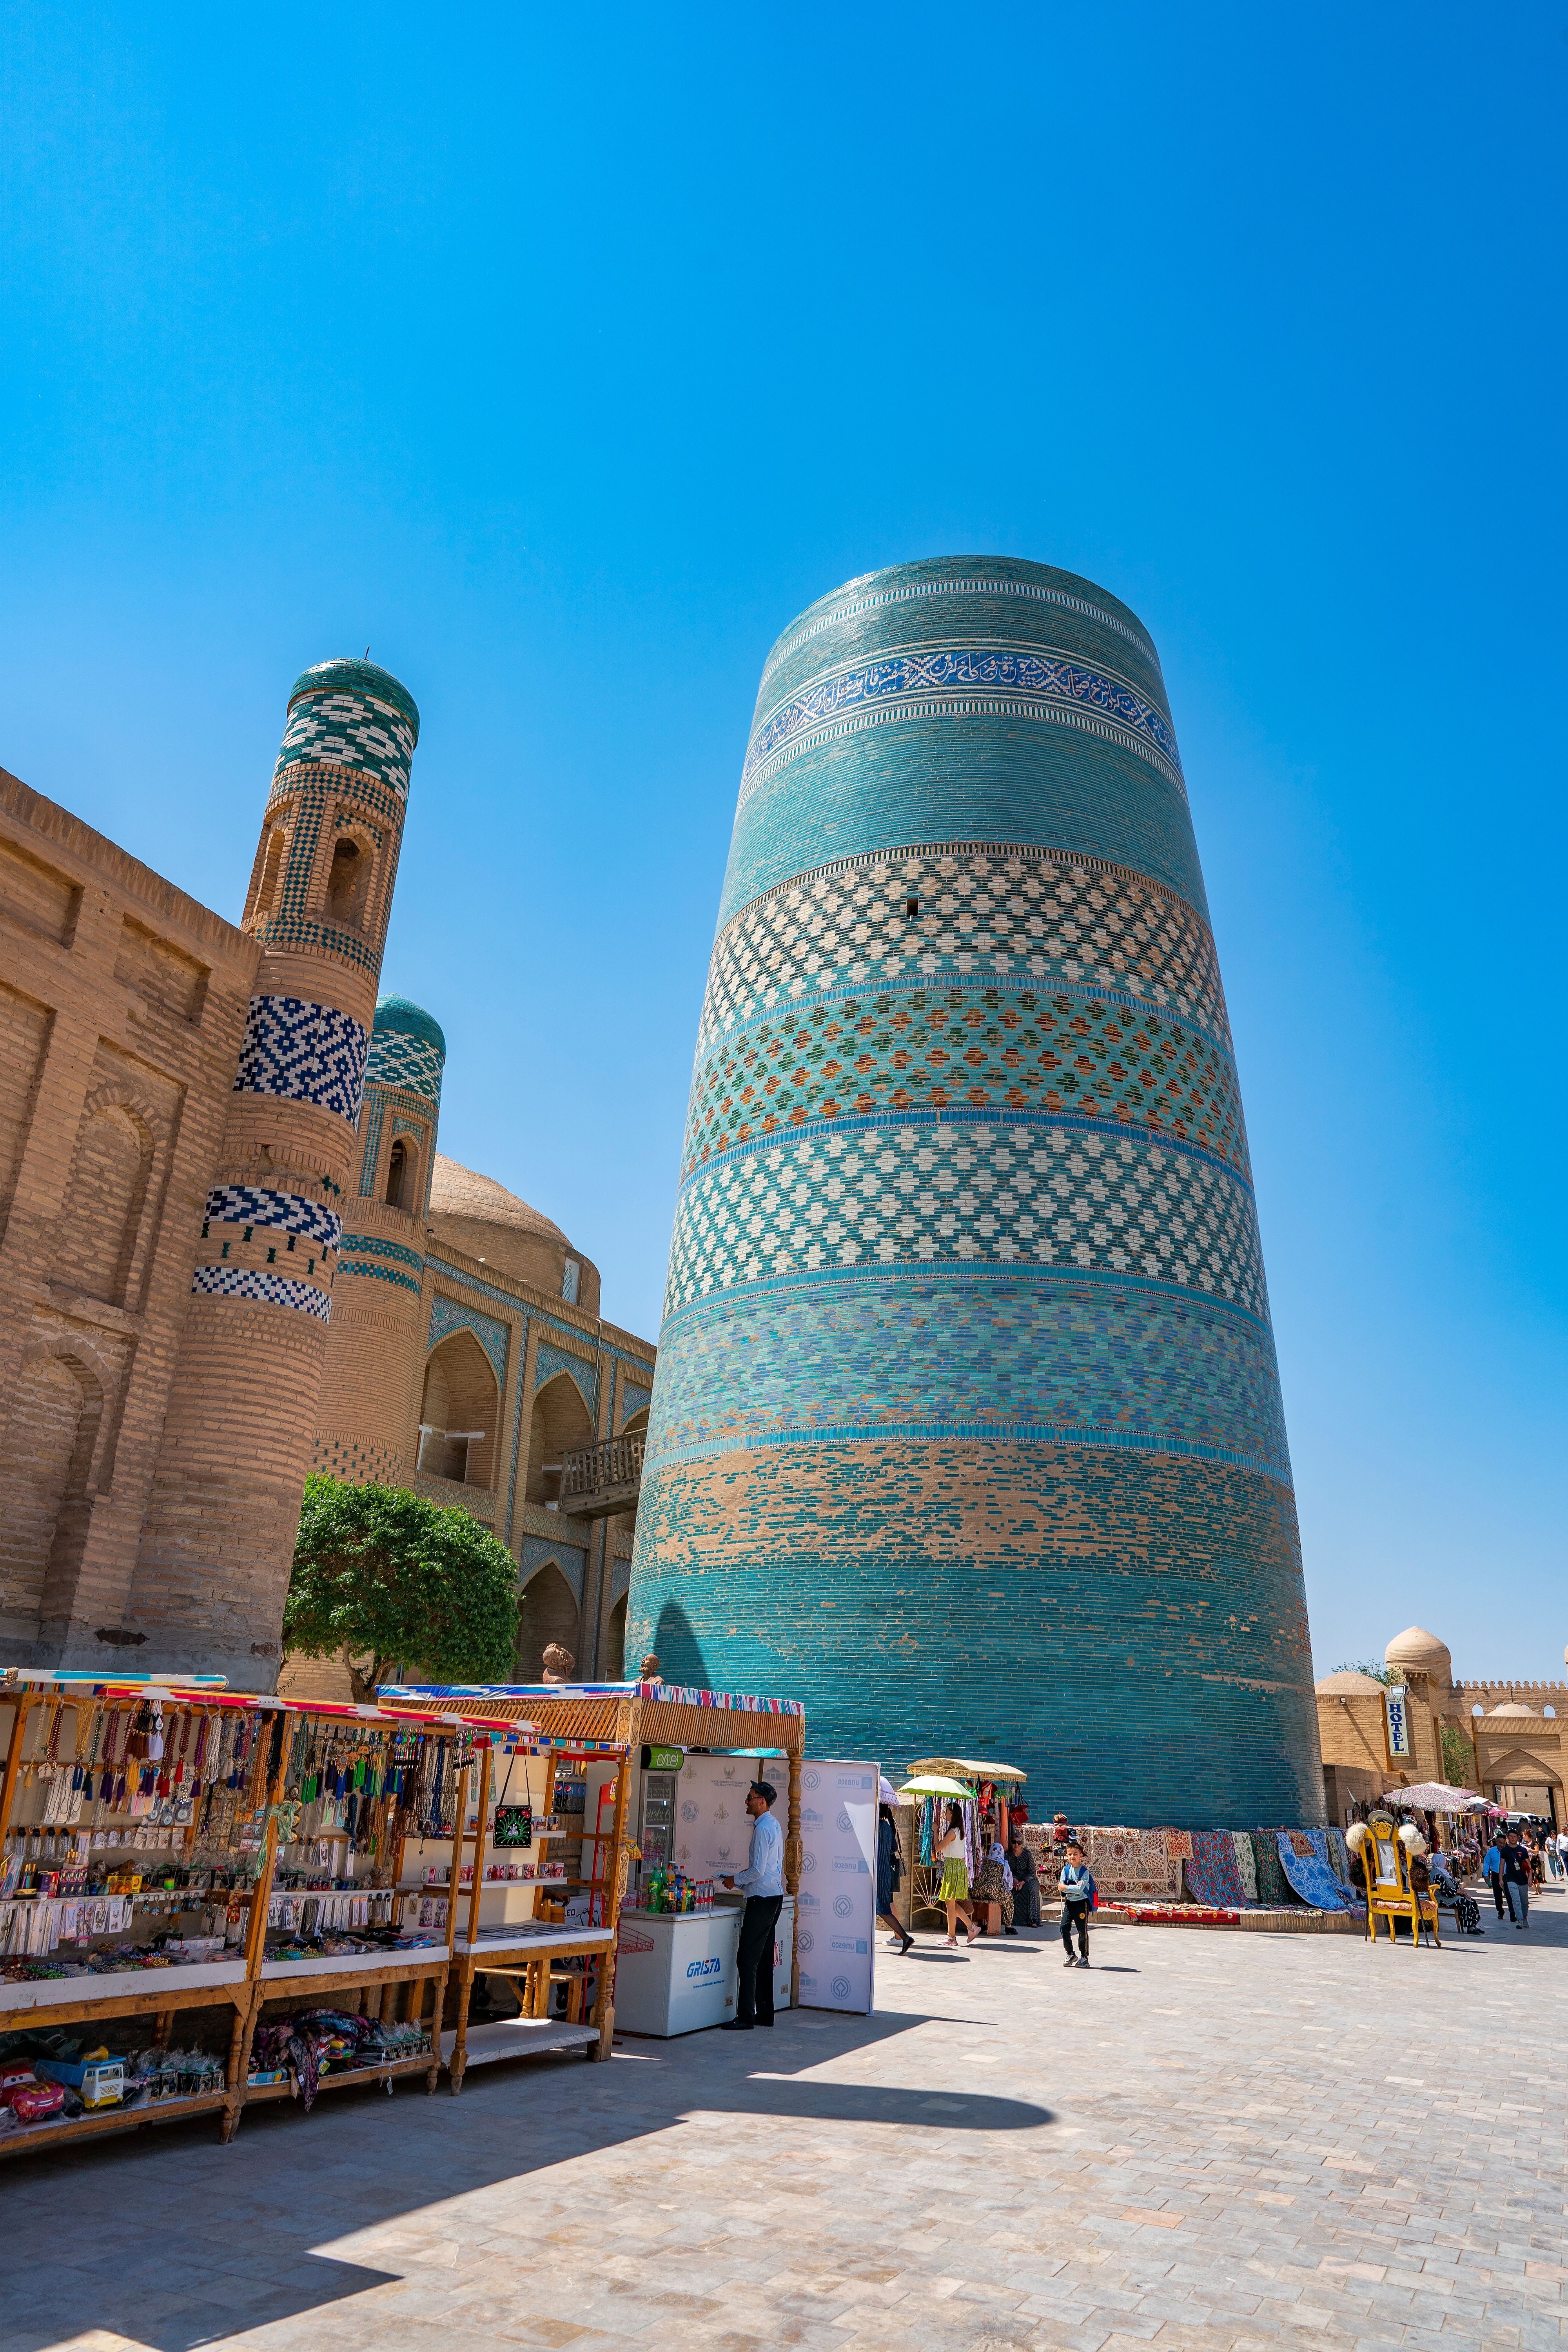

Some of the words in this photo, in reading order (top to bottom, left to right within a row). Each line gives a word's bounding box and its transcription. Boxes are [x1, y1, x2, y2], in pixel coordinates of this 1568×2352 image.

[1388, 1704, 1404, 1751] HOTEL
[564, 1908, 575, 1917] EO
[686, 1957, 720, 1978] GRISTA
